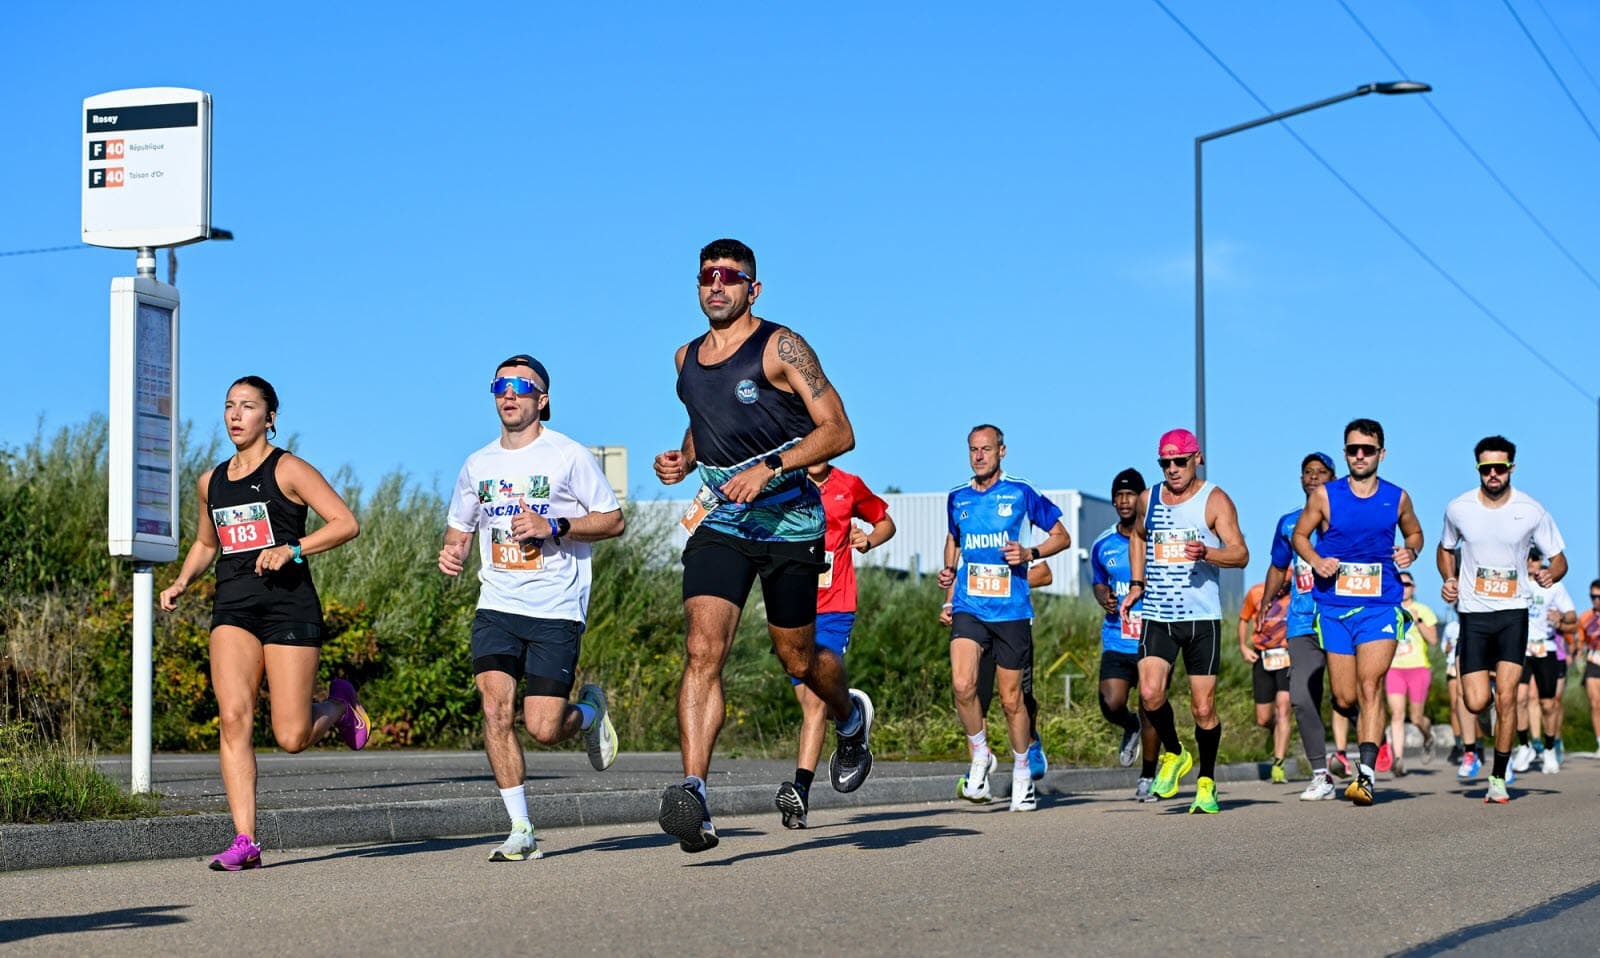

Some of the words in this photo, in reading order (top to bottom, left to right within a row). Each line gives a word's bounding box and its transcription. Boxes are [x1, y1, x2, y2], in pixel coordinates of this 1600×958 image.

[92, 114, 118, 124] Rosey
[129, 143, 164, 152] République
[129, 171, 149, 179] Toison
[228, 524, 257, 544] 183
[964, 530, 1010, 550] ANDINA
[1162, 544, 1186, 559] 555
[976, 578, 1000, 591] 518
[1345, 577, 1371, 590] 424
[1483, 580, 1509, 594] 526
